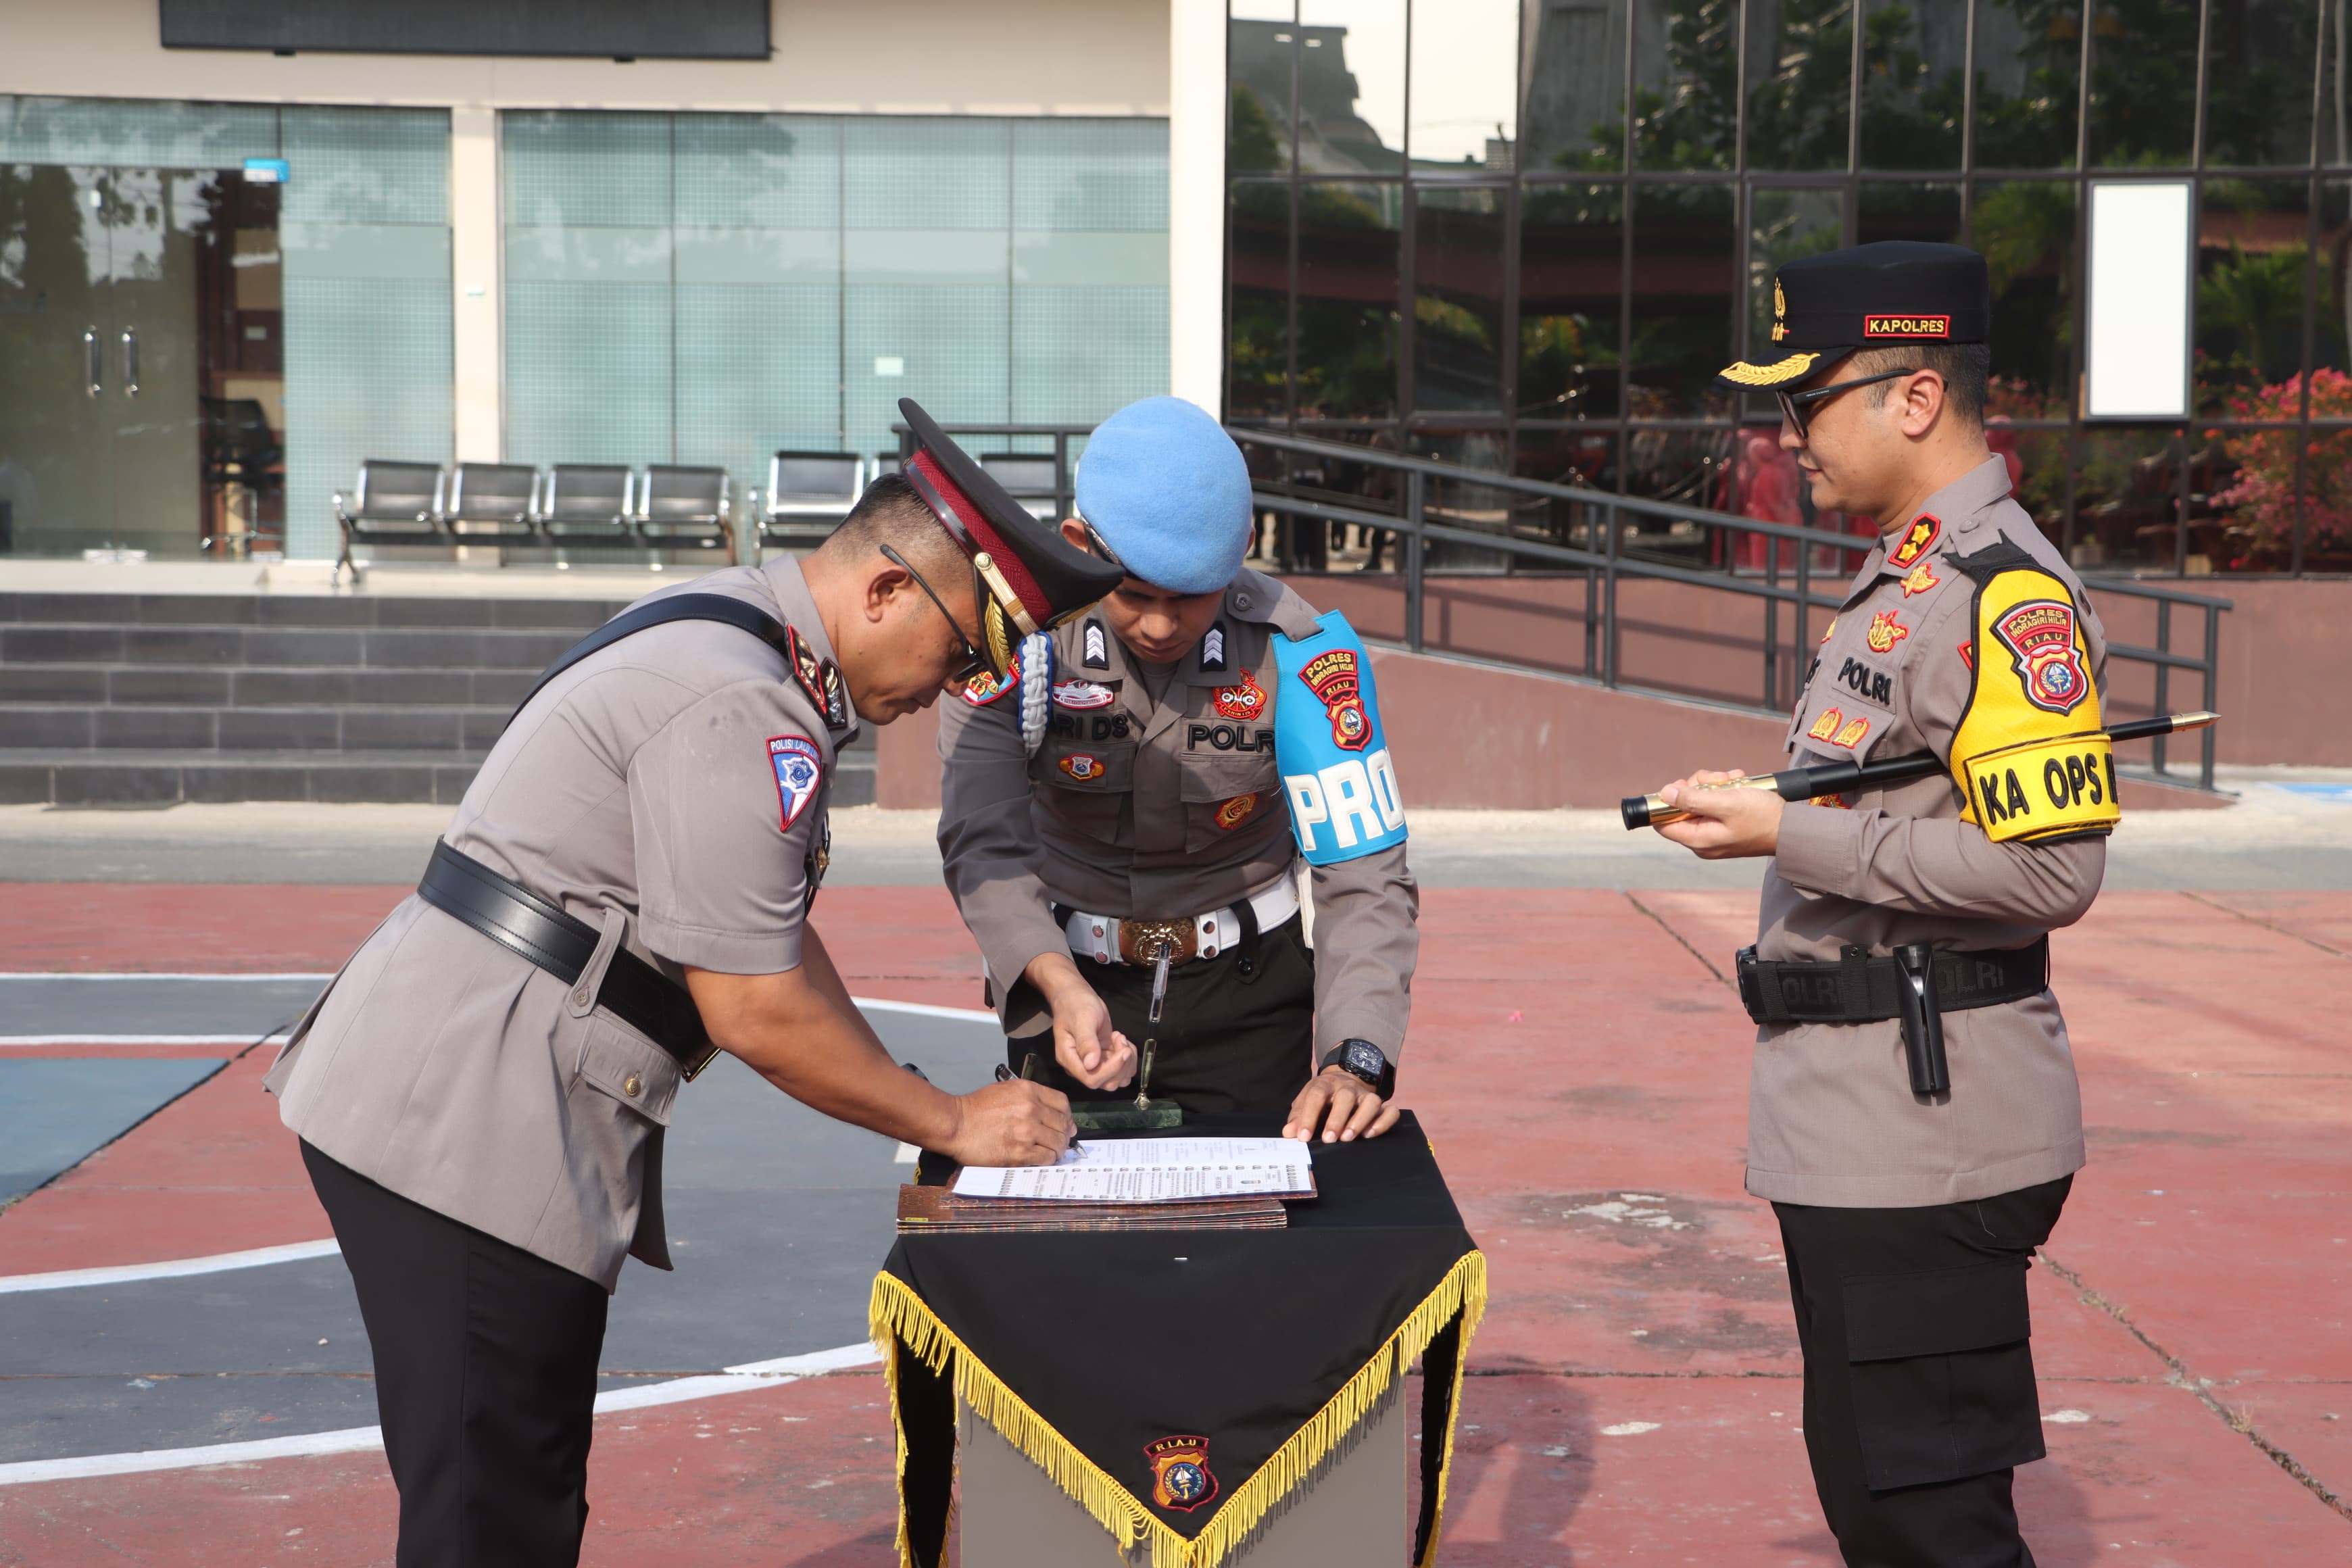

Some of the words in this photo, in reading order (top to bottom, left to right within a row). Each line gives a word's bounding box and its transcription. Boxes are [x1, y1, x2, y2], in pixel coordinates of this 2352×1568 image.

[1869, 319, 1944, 333] KAPOLRES
[2008, 609, 2064, 631] POLRES
[2011, 616, 2047, 638] INDRAGIRI
[2048, 616, 2067, 627] HILIR
[2025, 633, 2062, 649] RIAU
[1306, 653, 1351, 678] POLRES
[1310, 664, 1338, 686] INDRAGIRI
[1326, 681, 1350, 696] RIAU
[1838, 657, 1892, 706] POLRI
[1092, 714, 1130, 741] DS
[770, 739, 793, 752] POLISI
[1979, 768, 2030, 825] KA
[2044, 752, 2102, 810] OPS
[1284, 748, 1404, 852] PRO
[1156, 1438, 1196, 1452] RIAU
